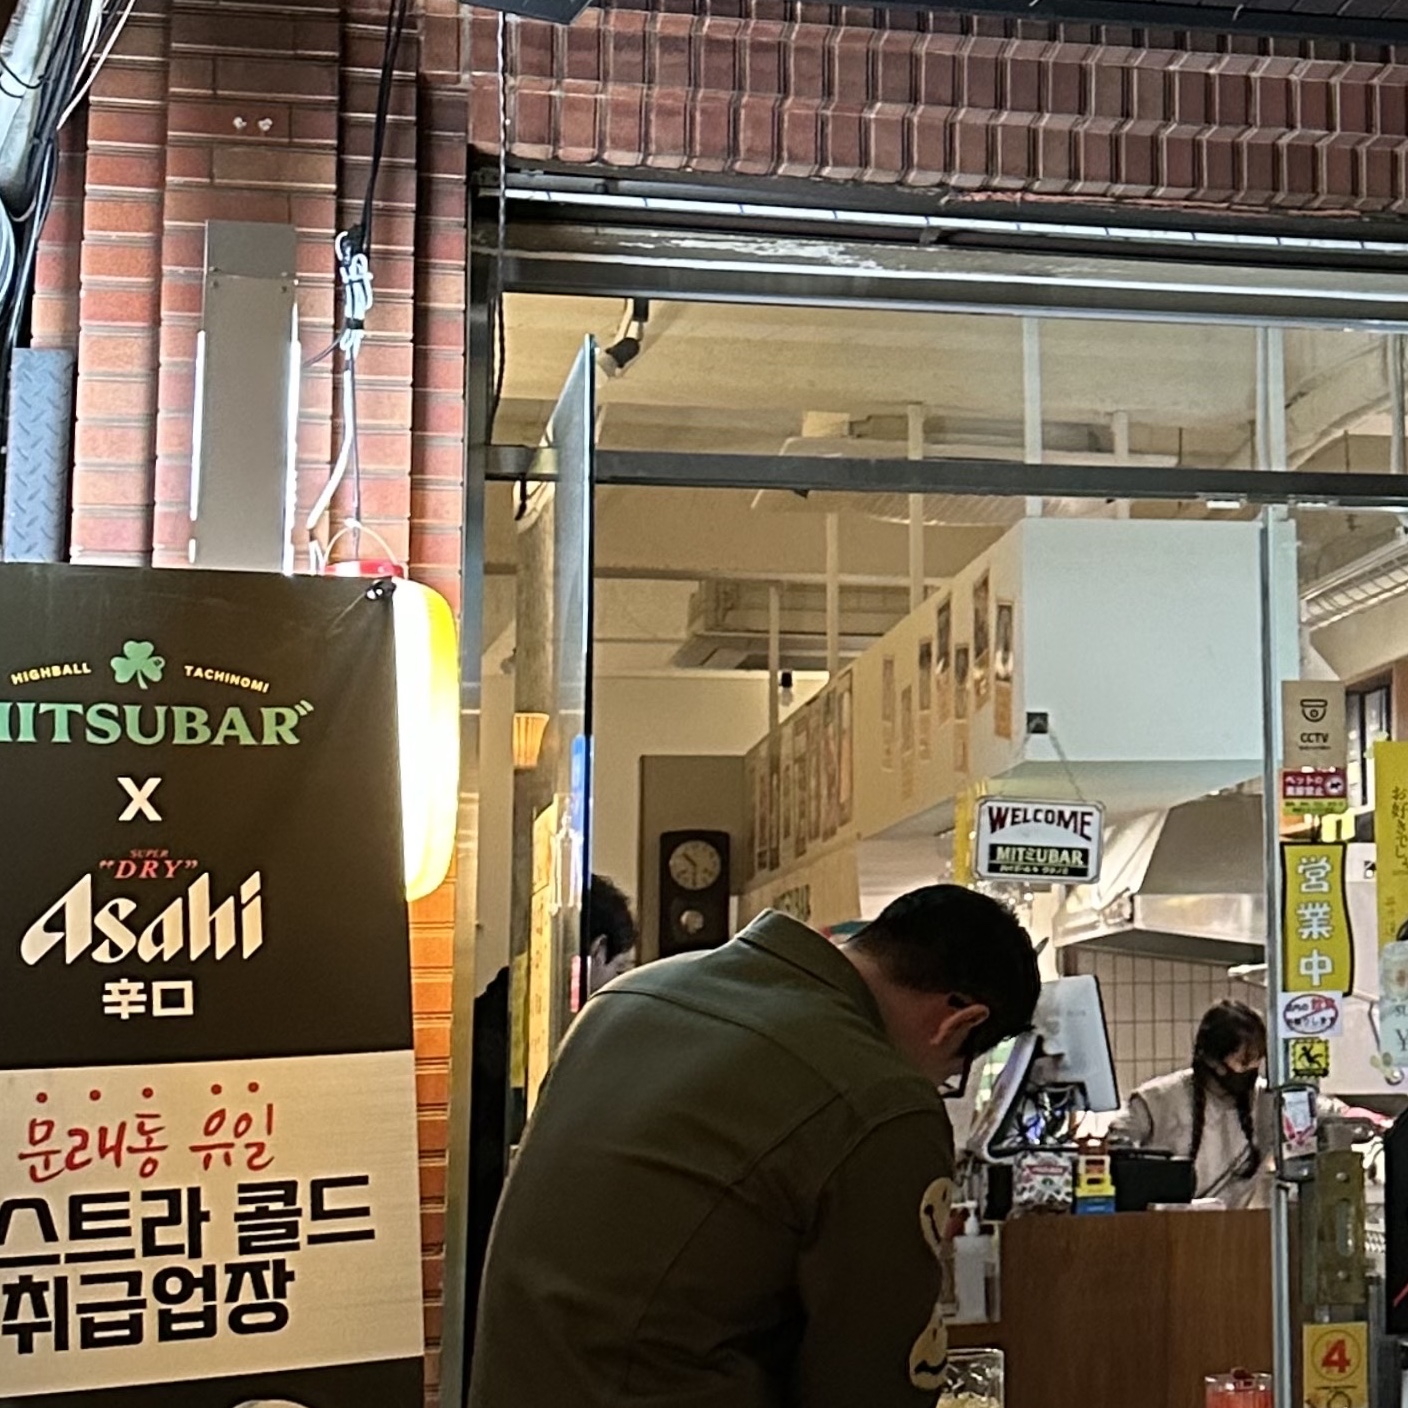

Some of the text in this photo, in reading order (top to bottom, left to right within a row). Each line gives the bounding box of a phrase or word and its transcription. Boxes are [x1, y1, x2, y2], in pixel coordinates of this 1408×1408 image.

[11, 662, 91, 685] HIGHBALL
[184, 665, 270, 693] TACHINOMI
[1300, 732, 1329, 744] CCTV
[117, 777, 162, 821] X
[987, 805, 1094, 842] WELCOME
[20, 871, 263, 965] Asahi
[1297, 855, 1333, 987] 営業中
[102, 979, 194, 1019] 辛口
[18, 1103, 275, 1183] 문래동 유일
[234, 1175, 375, 1256] 콜드
[2, 1258, 296, 1354] 취급업장
[1321, 1338, 1351, 1373] 4
